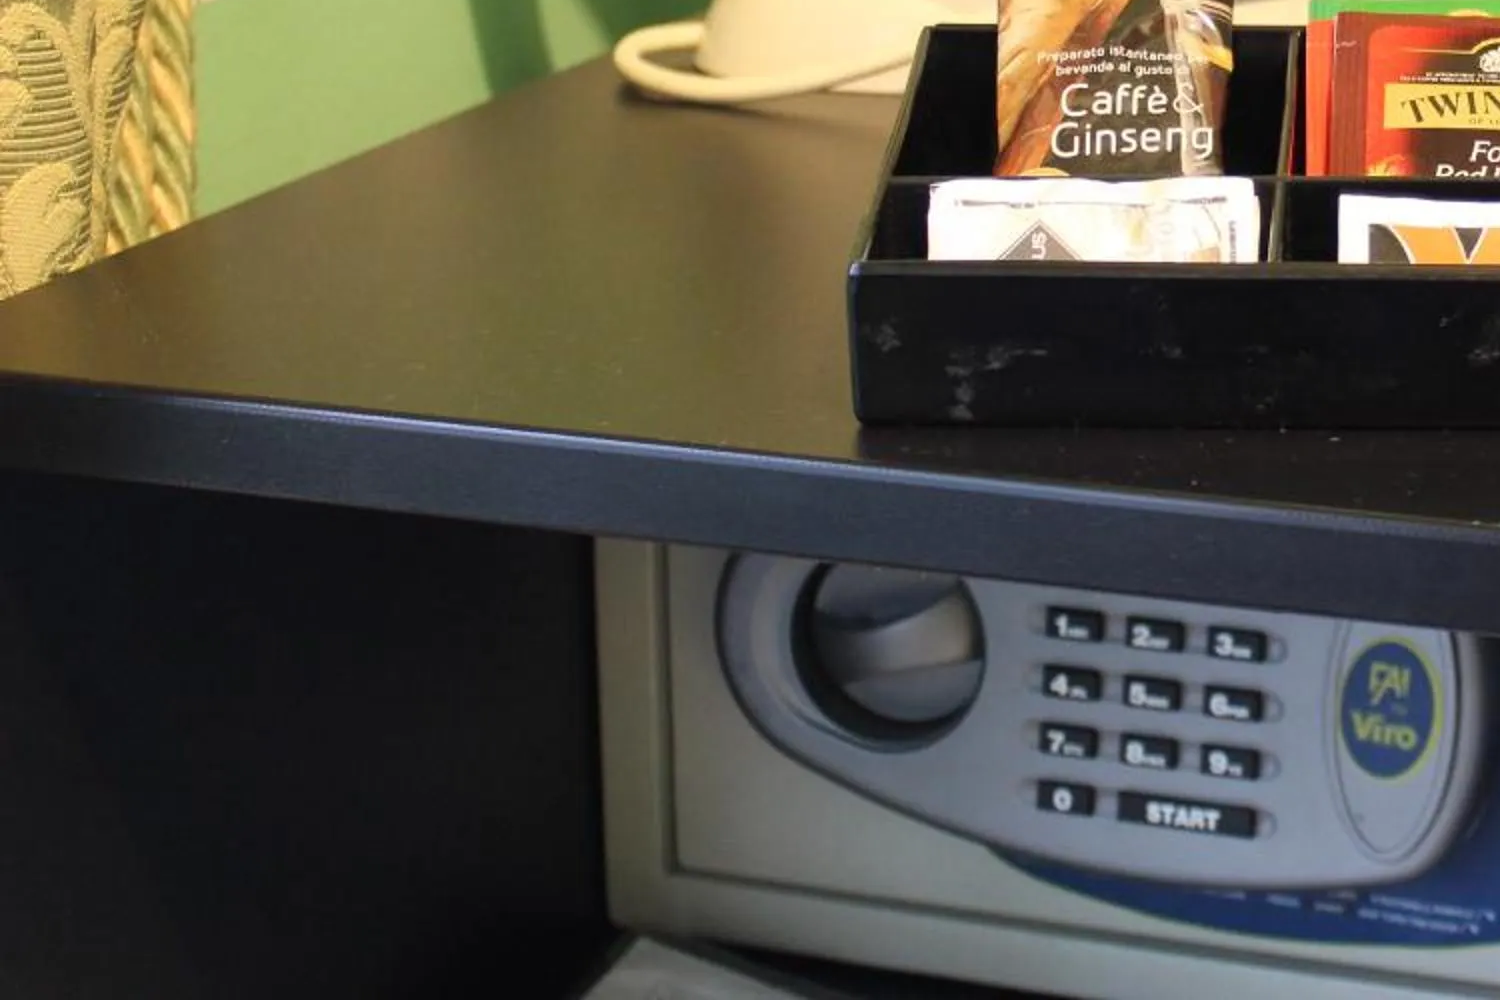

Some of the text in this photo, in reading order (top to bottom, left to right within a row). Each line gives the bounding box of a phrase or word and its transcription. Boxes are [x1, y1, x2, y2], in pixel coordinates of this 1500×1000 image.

[1037, 47, 1105, 64] Preparato
[1134, 64, 1173, 77] gusto
[1060, 83, 1169, 117] Caffè
[1051, 122, 1214, 160] Ginseng
[1350, 710, 1418, 752] Viro
[1145, 801, 1221, 831] START
